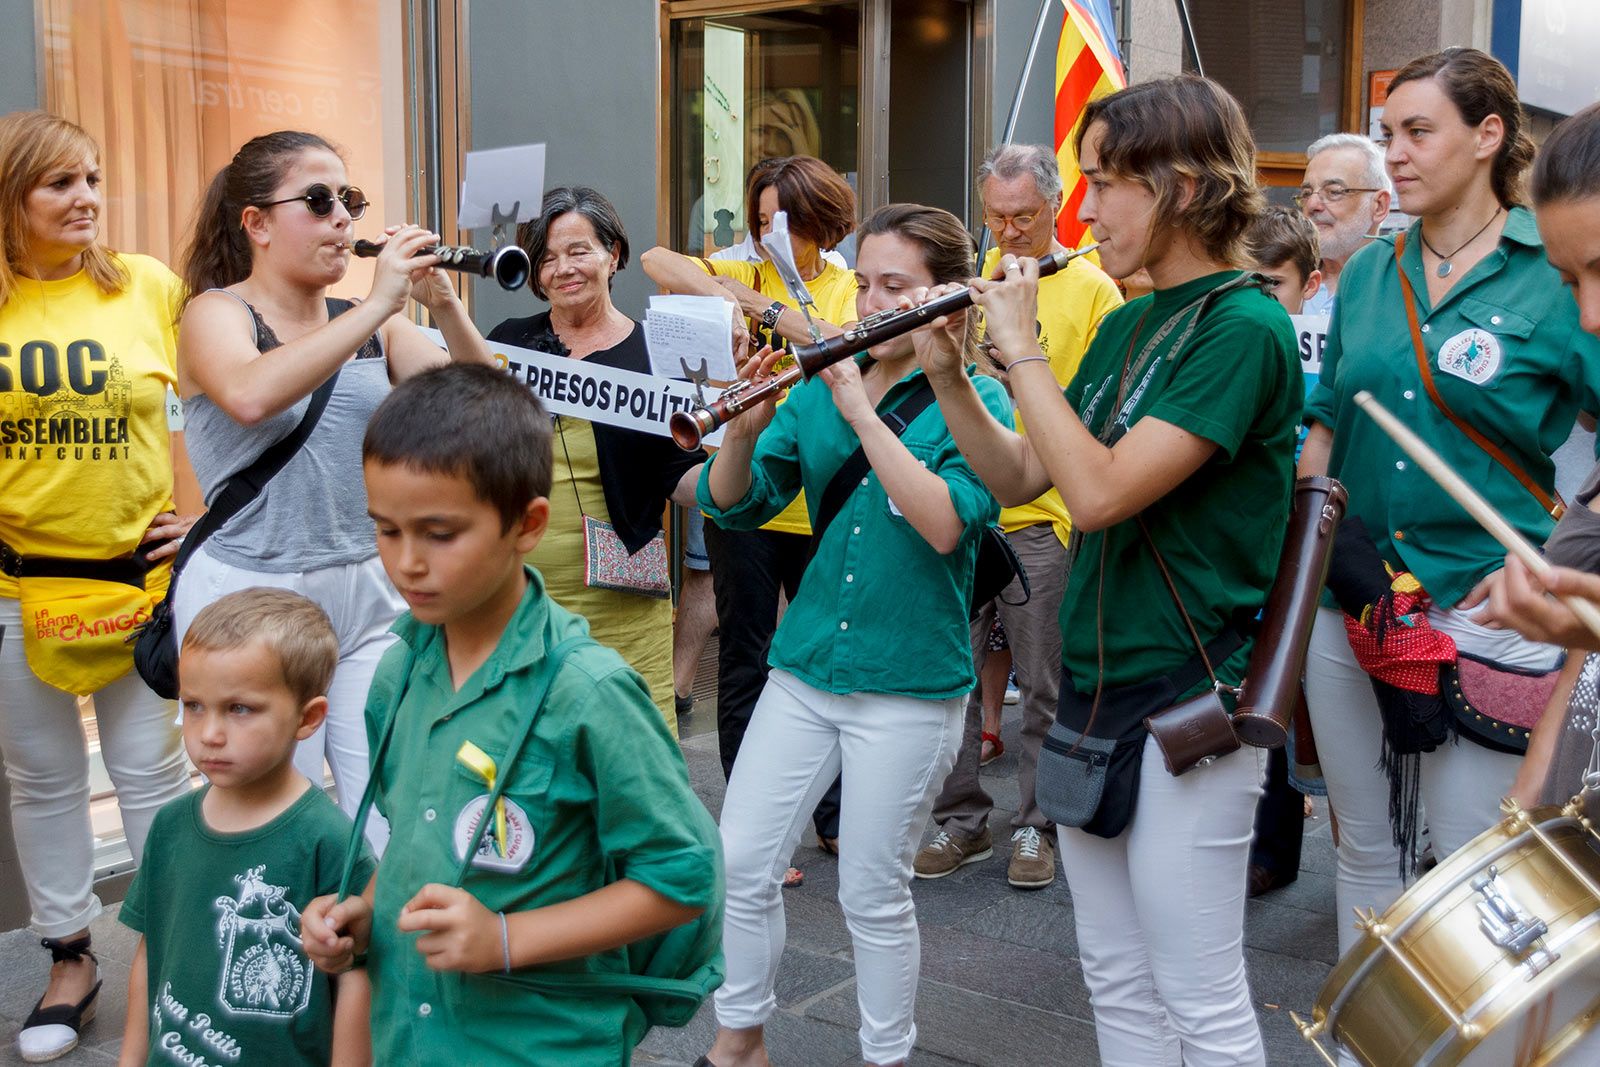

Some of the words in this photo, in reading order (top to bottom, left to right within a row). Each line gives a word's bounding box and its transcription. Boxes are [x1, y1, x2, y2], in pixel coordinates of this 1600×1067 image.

[526, 365, 613, 411] PRESOS
[614, 384, 698, 424] POLÍTI
[0, 417, 129, 445] SSEMBLEA
[57, 446, 130, 461] CUGAT
[35, 609, 49, 620] LA
[37, 627, 58, 640] DEL
[273, 942, 287, 954] DE
[285, 949, 304, 972] SANT
[231, 943, 264, 999] CASTELLERS
[287, 973, 304, 1005] CUGAT
[189, 1012, 242, 1057] Petits
